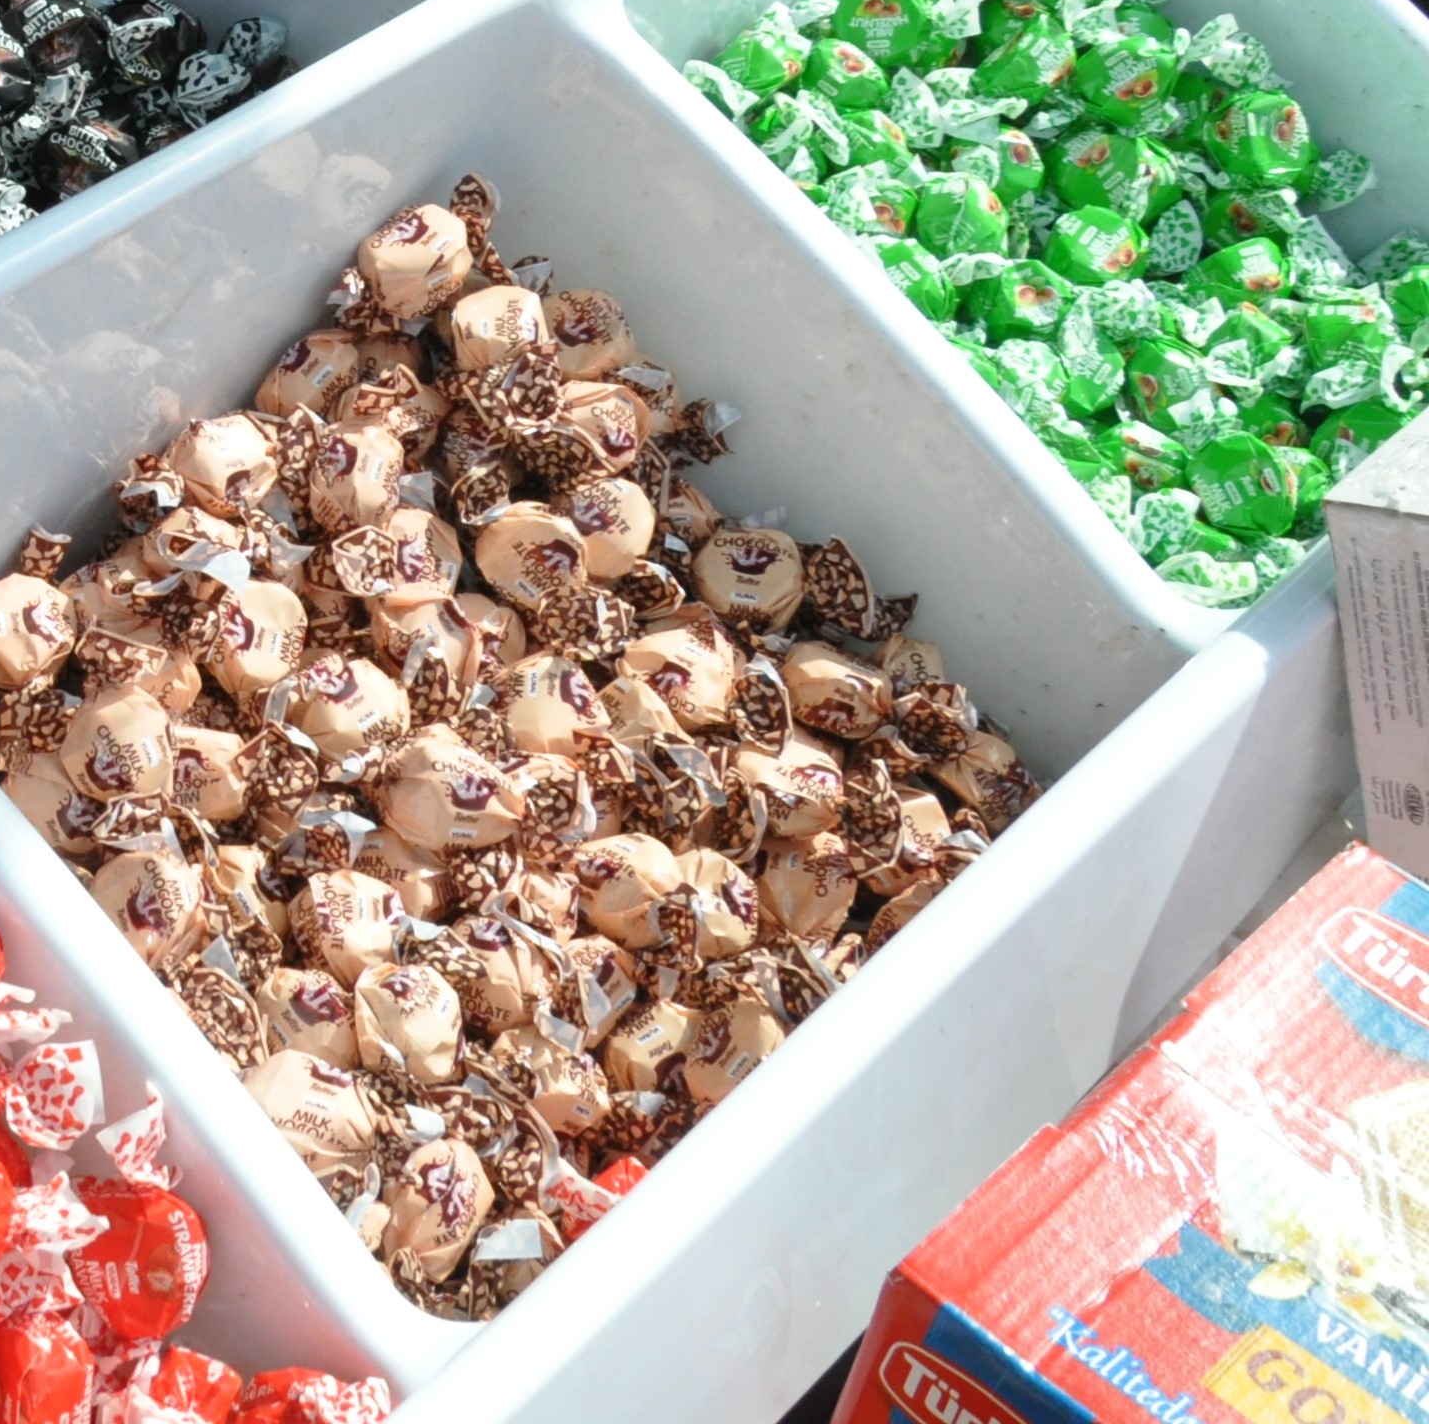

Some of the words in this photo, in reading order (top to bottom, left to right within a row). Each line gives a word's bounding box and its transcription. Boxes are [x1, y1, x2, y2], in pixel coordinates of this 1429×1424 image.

[50, 130, 118, 174] CHOCOLATE
[65, 123, 106, 154] BITTER
[558, 289, 613, 348] CHOCOLATE
[583, 294, 612, 325] MILK
[592, 480, 624, 504] MILK
[713, 537, 796, 561] CHOCOLATE
[735, 576, 762, 587] Toffee
[362, 716, 390, 743] MILK
[453, 812, 480, 826] Toffee
[315, 875, 343, 950] CHOCOLATE
[339, 892, 352, 924] MILK
[371, 897, 380, 922] Toffee
[308, 1081, 339, 1098] Toffee
[292, 1108, 332, 1135] MILK
